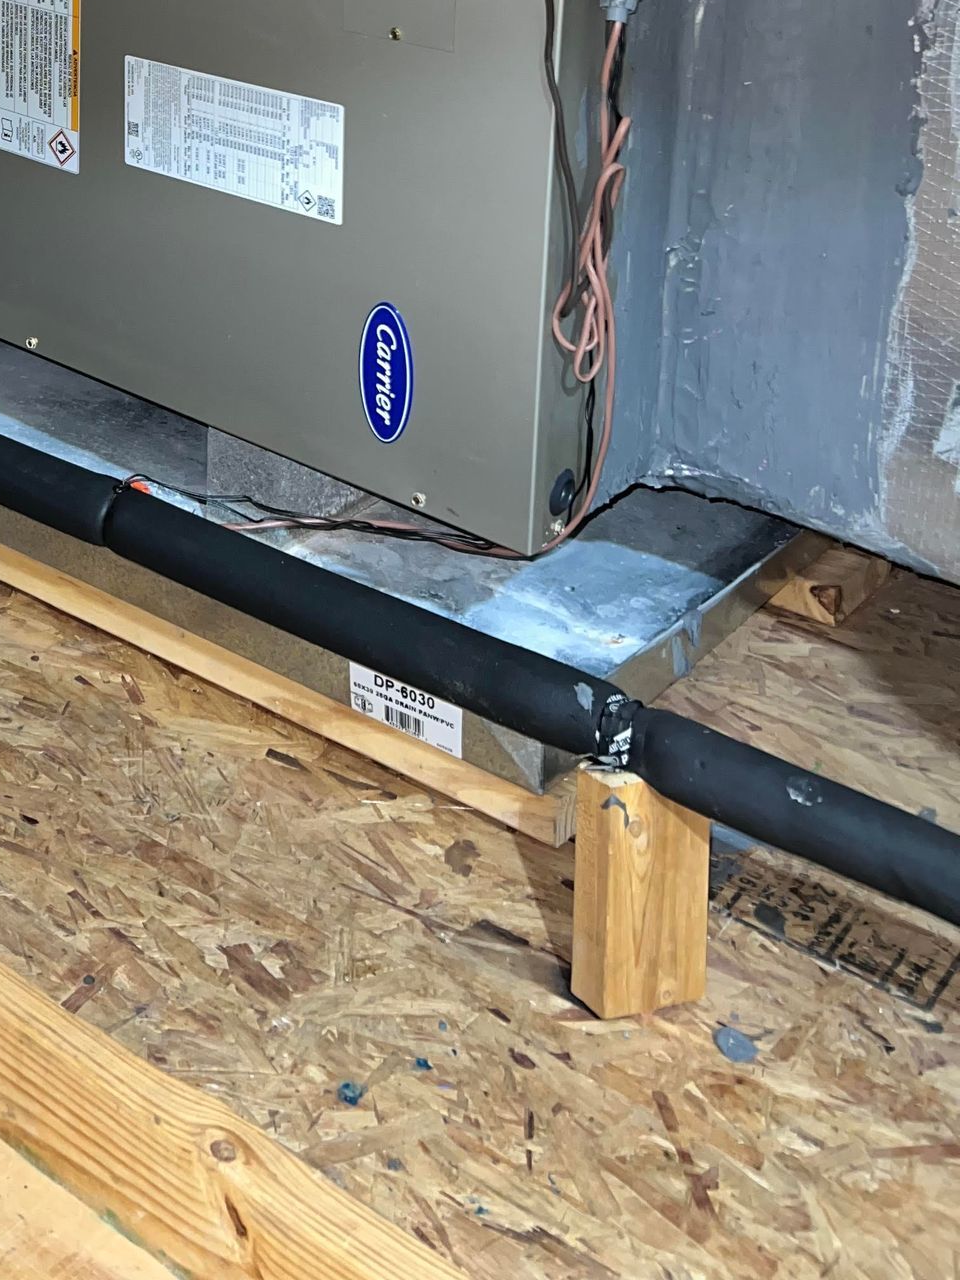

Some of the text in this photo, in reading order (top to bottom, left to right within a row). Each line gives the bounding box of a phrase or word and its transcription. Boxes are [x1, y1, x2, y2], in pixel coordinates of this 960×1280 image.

[373, 323, 396, 425] Carrier
[374, 674, 435, 709] DP-6030
[394, 699, 417, 712] DRAIN
